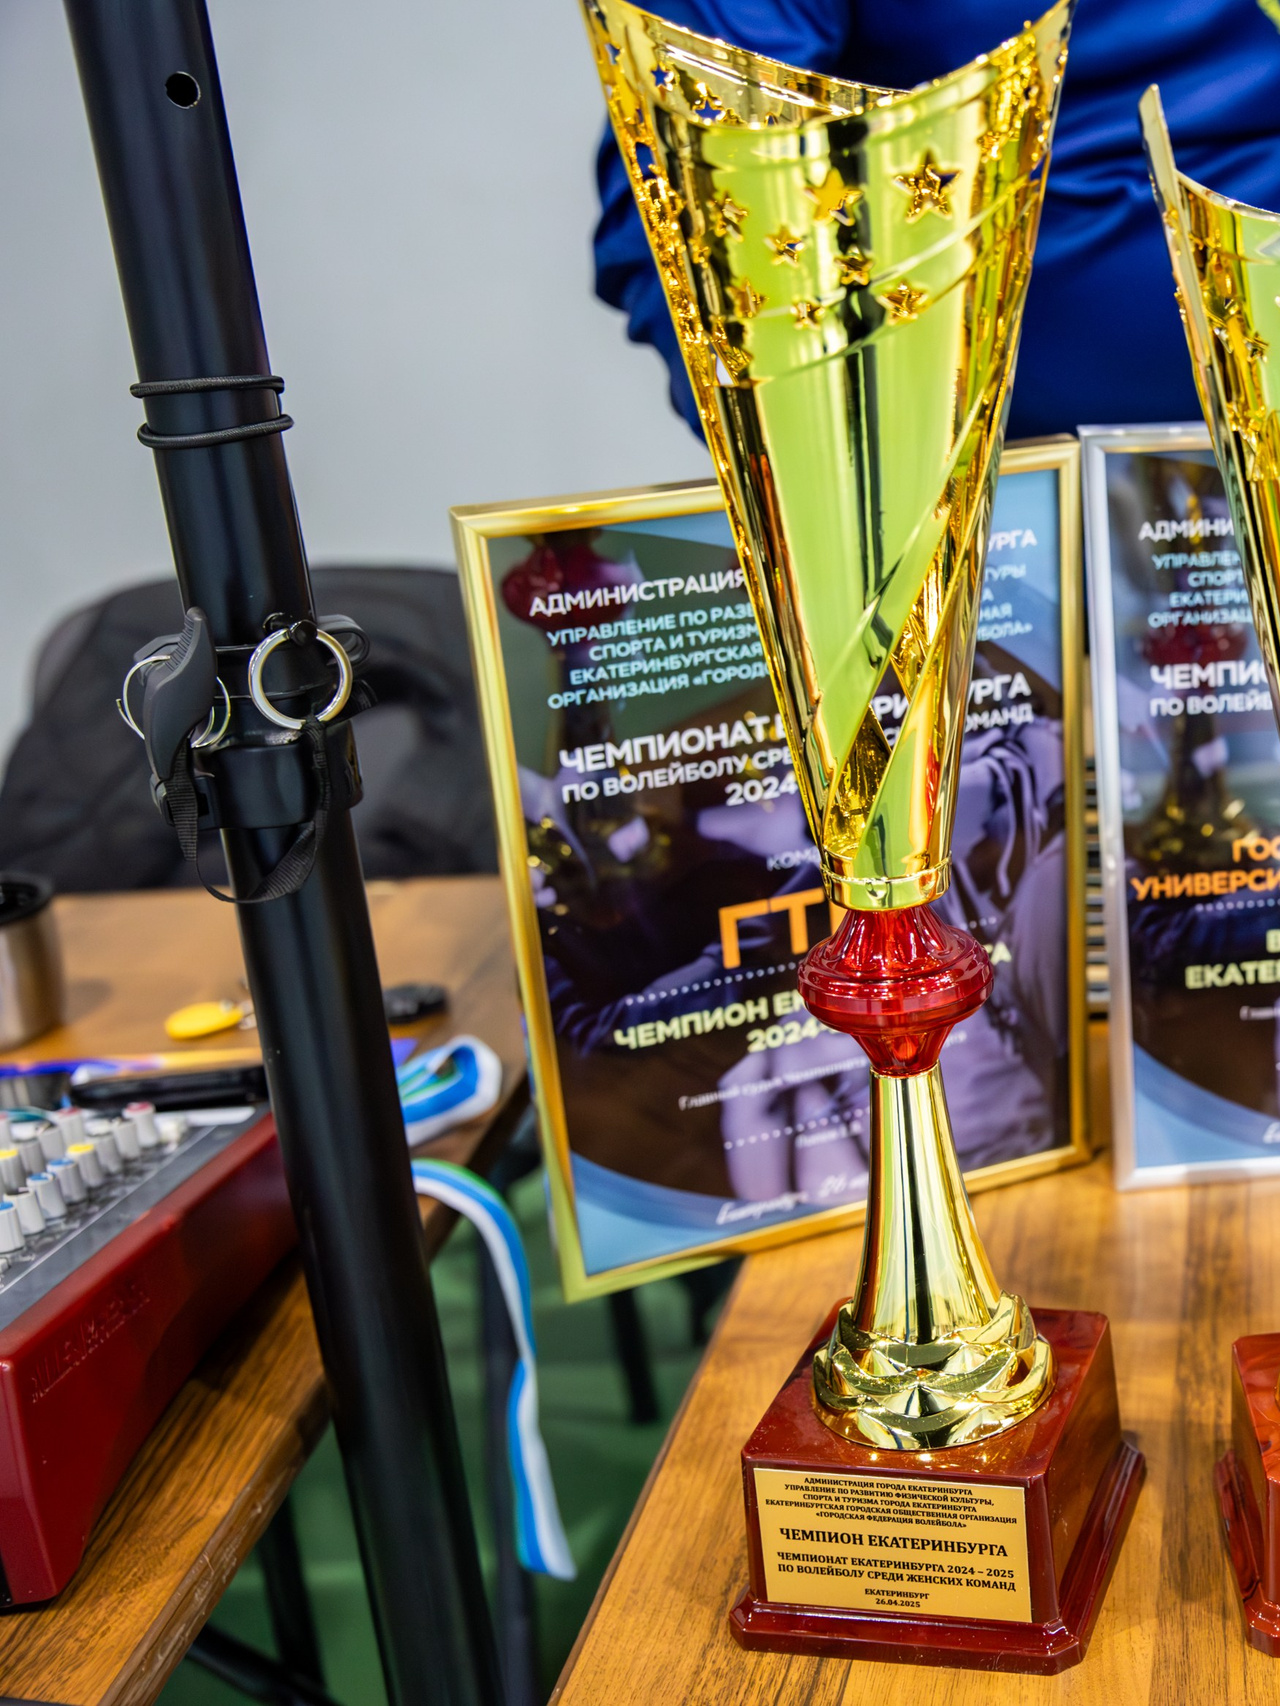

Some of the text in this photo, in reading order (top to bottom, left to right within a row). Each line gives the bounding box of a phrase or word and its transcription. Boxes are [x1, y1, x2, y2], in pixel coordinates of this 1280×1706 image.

[529, 568, 750, 616] АДМИНИСТРАЦИЯ
[1188, 570, 1244, 587] СПОРТ
[547, 612, 676, 646] УПРАВЛЕНИЕ
[680, 610, 707, 626] ПО
[1148, 608, 1252, 628] ОРГАНИЗАЦ
[589, 624, 760, 661] СПОРТА И ТУРИЗМ
[570, 642, 763, 685] ЕКАТЕРИНБУРГСКАЯ
[1150, 659, 1268, 689] ЧЕМПИ
[548, 662, 770, 709] ОРГАНИЗАЦИЯ «ГОРОД
[1151, 697, 1183, 717] ПО
[559, 716, 770, 774] ЧЕМПИОНАТ
[562, 754, 749, 803] ПО ВОЛЕЙБОЛУ
[725, 773, 798, 806] 2024
[718, 887, 846, 969] ГТ
[614, 1000, 768, 1050] ЧЕМПИОН
[784, 1484, 836, 1494] УПРАВЛЕНИЕ
[850, 1489, 894, 1498] РАЗВИТИЮ
[894, 1492, 948, 1502] ФИЗИЧЕСКОЙ
[950, 1496, 994, 1506] КУЛЬТУРЫ,
[804, 1478, 972, 1496] АДМИНИСТРАЦИЯ ГОРОДА ЕКАТЕРИНБУРГА
[765, 1499, 1017, 1524] ЕКАТЕРИНБУРГСКАЯ ГОРОДСКАЯ ОБЩЕСТВЕННАЯ ОРГАНИЗАЦИЯ
[802, 1494, 832, 1502] СПОРТА
[841, 1496, 878, 1505] ТУРИЗМА
[880, 1499, 910, 1508] ГОРОДА
[912, 1502, 977, 1513] ЕКАТЕРИНБУРГА
[816, 1511, 967, 1528] «ГОРОДСКАЯ ФЕДЕРАЦИЯ ВОЛЕЙБОЛА»
[780, 1528, 1008, 1557] ЧЕМПИОН ЕКАТЕРИНБУРГА
[777, 1551, 1014, 1578] ЧЕМПИОНАТ ЕКАТЕРИНБУРГА 2024 2025
[778, 1563, 1016, 1592] ПО ВОЛЕЙБОЛУ СРЕДИ ЖЕНСКИХ КОМАНД
[864, 1588, 930, 1600] ЕКАТЕРИНБУРГ
[875, 1598, 921, 1608] 26.04.2025
